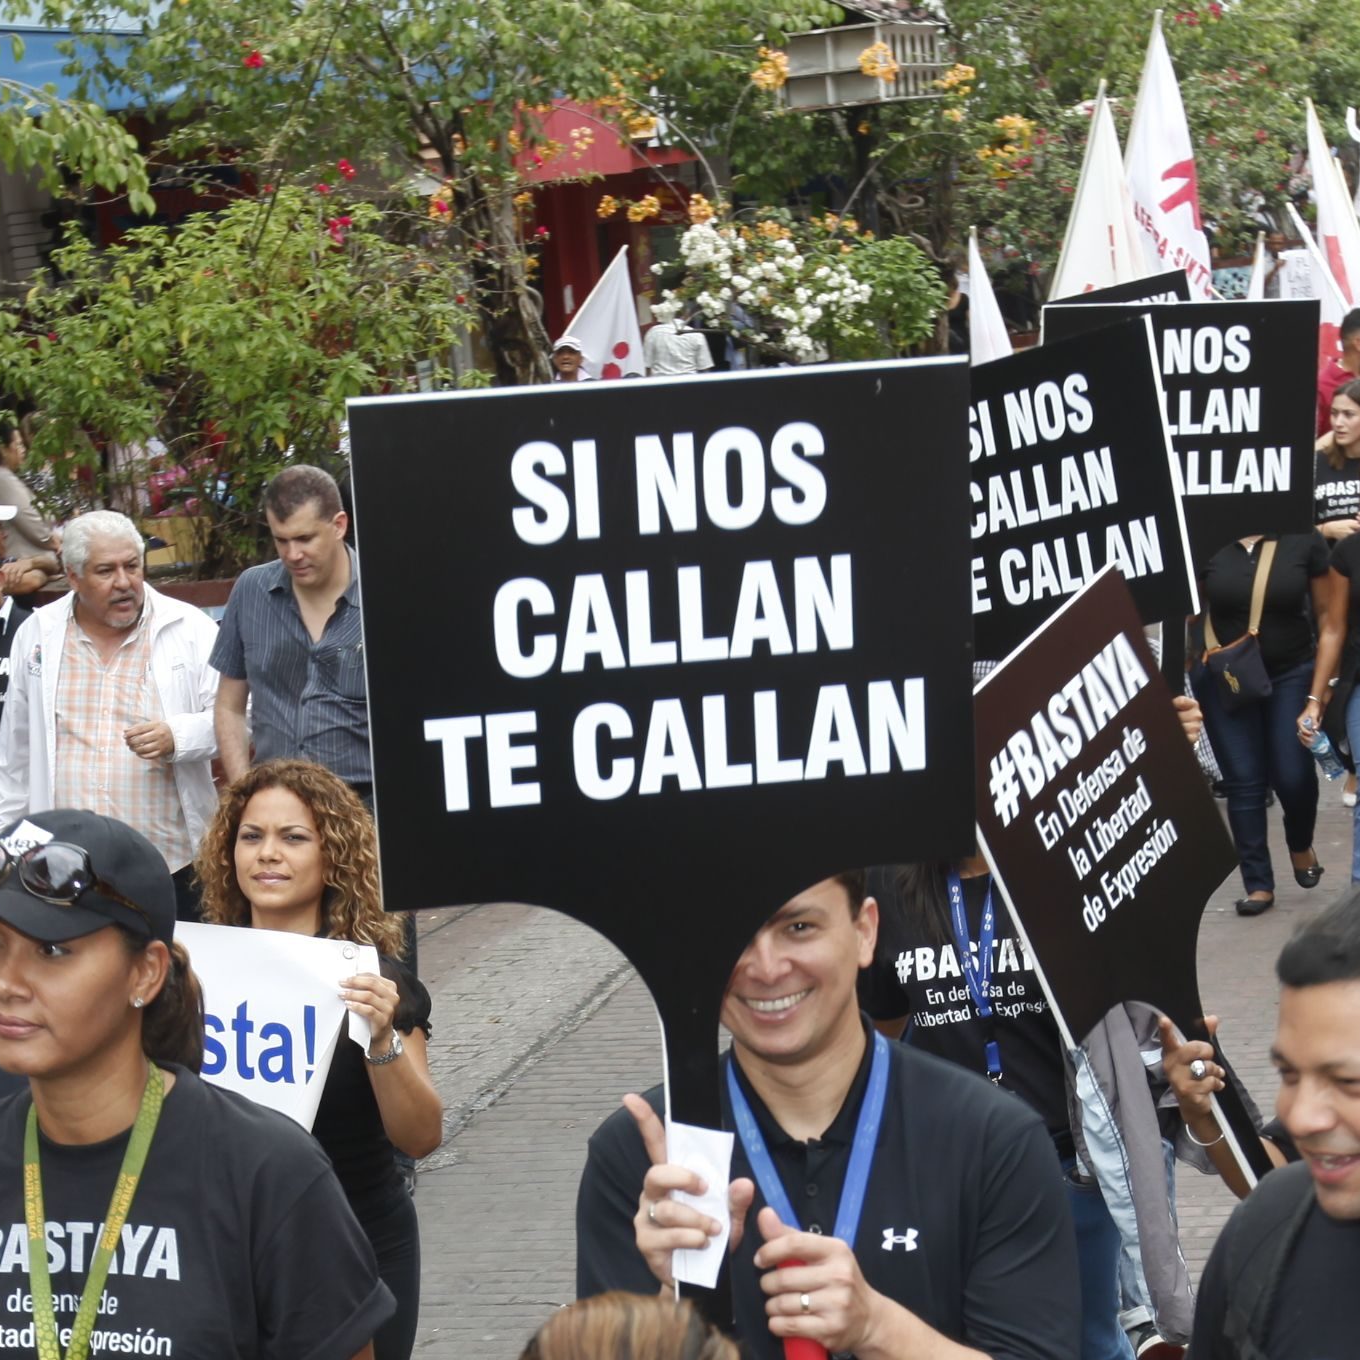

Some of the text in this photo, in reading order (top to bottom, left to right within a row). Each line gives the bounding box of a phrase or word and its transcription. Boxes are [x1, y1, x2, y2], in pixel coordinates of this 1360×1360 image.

[1163, 325, 1251, 375] NOS
[1004, 373, 1093, 450] NOS
[511, 420, 828, 545] SI NOS
[999, 515, 1164, 605] CALLAN
[492, 552, 855, 679] CALLAN
[423, 676, 927, 813] TE CALLAN
[989, 631, 1151, 828] #BASTAYA
[1034, 726, 1147, 851] En Defensa de
[1068, 775, 1153, 880] la Libertad
[1082, 818, 1179, 933] de Expresión
[926, 988, 944, 1005] En
[1007, 981, 1025, 997] de
[26, 1201, 38, 1240] AFRICA
[106, 1175, 138, 1252] SOUTH AFRICA
